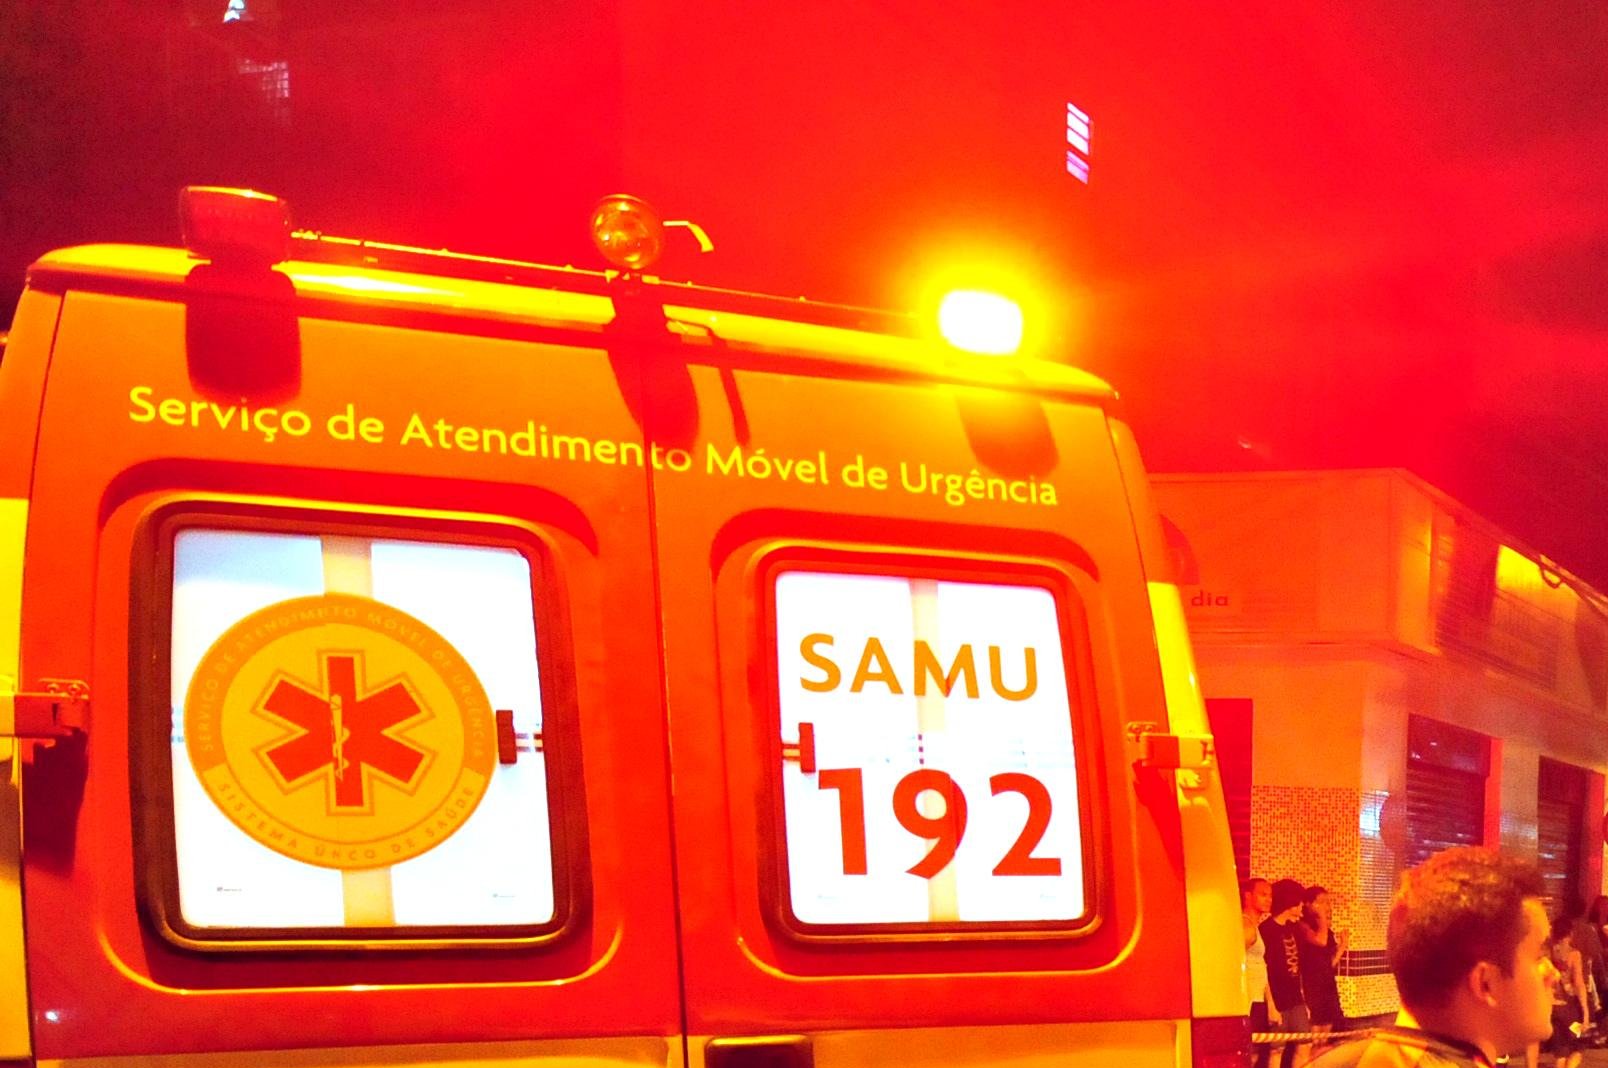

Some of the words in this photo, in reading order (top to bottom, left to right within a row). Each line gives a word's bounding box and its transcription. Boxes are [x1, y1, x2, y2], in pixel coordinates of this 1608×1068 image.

[129, 386, 311, 442] Serviço
[327, 404, 384, 443] de
[400, 413, 692, 472] Atendimento
[707, 443, 829, 485] Móvel
[842, 455, 888, 490] de
[900, 464, 1058, 506] Urgência
[799, 633, 1038, 701] SAMU
[218, 783, 297, 849] SISTEMA
[391, 838, 416, 854] DE
[818, 767, 1062, 880] 192
